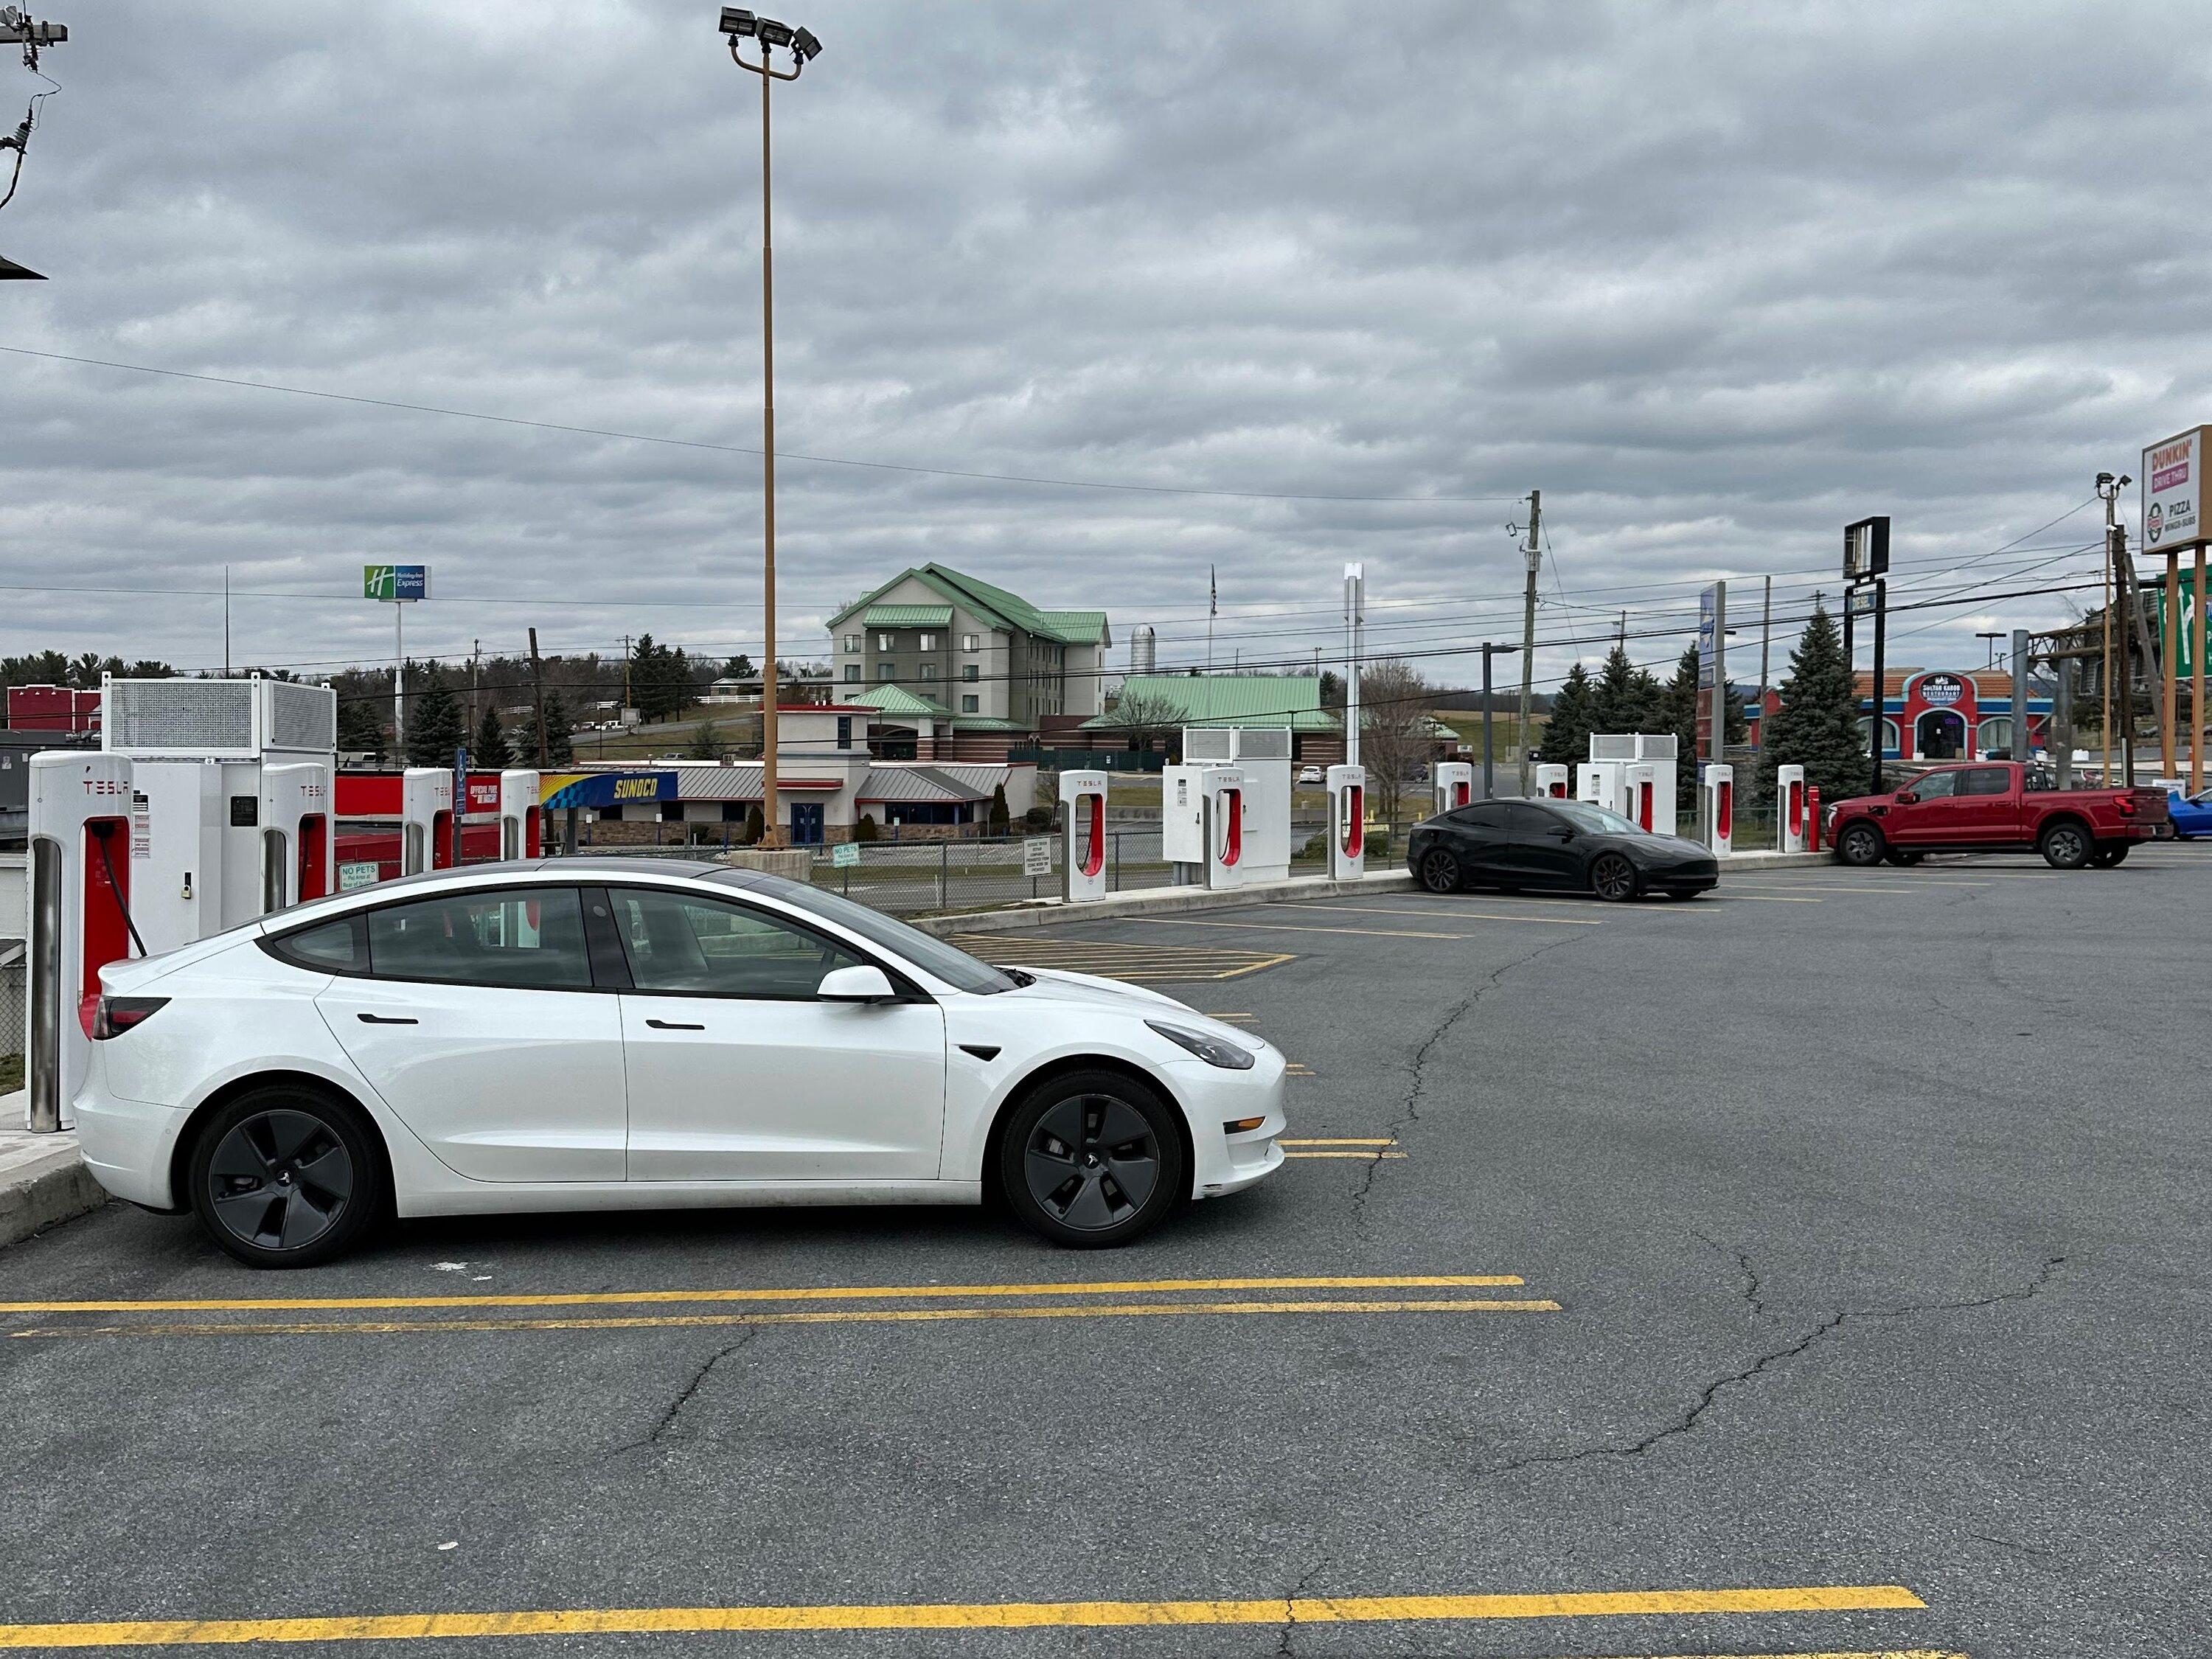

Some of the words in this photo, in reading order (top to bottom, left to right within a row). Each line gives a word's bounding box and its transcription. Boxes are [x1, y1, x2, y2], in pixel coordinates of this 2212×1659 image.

[2152, 439, 2192, 472] DUNKIN'
[2153, 475, 2171, 489] DRIVE
[2171, 467, 2187, 483] THRU
[2168, 499, 2191, 517] PIZZA
[397, 579, 424, 588] Express
[83, 781, 128, 795] TESLA
[613, 778, 658, 799] SUNOCO
[342, 867, 354, 875] NO
[355, 865, 375, 874] PETS
